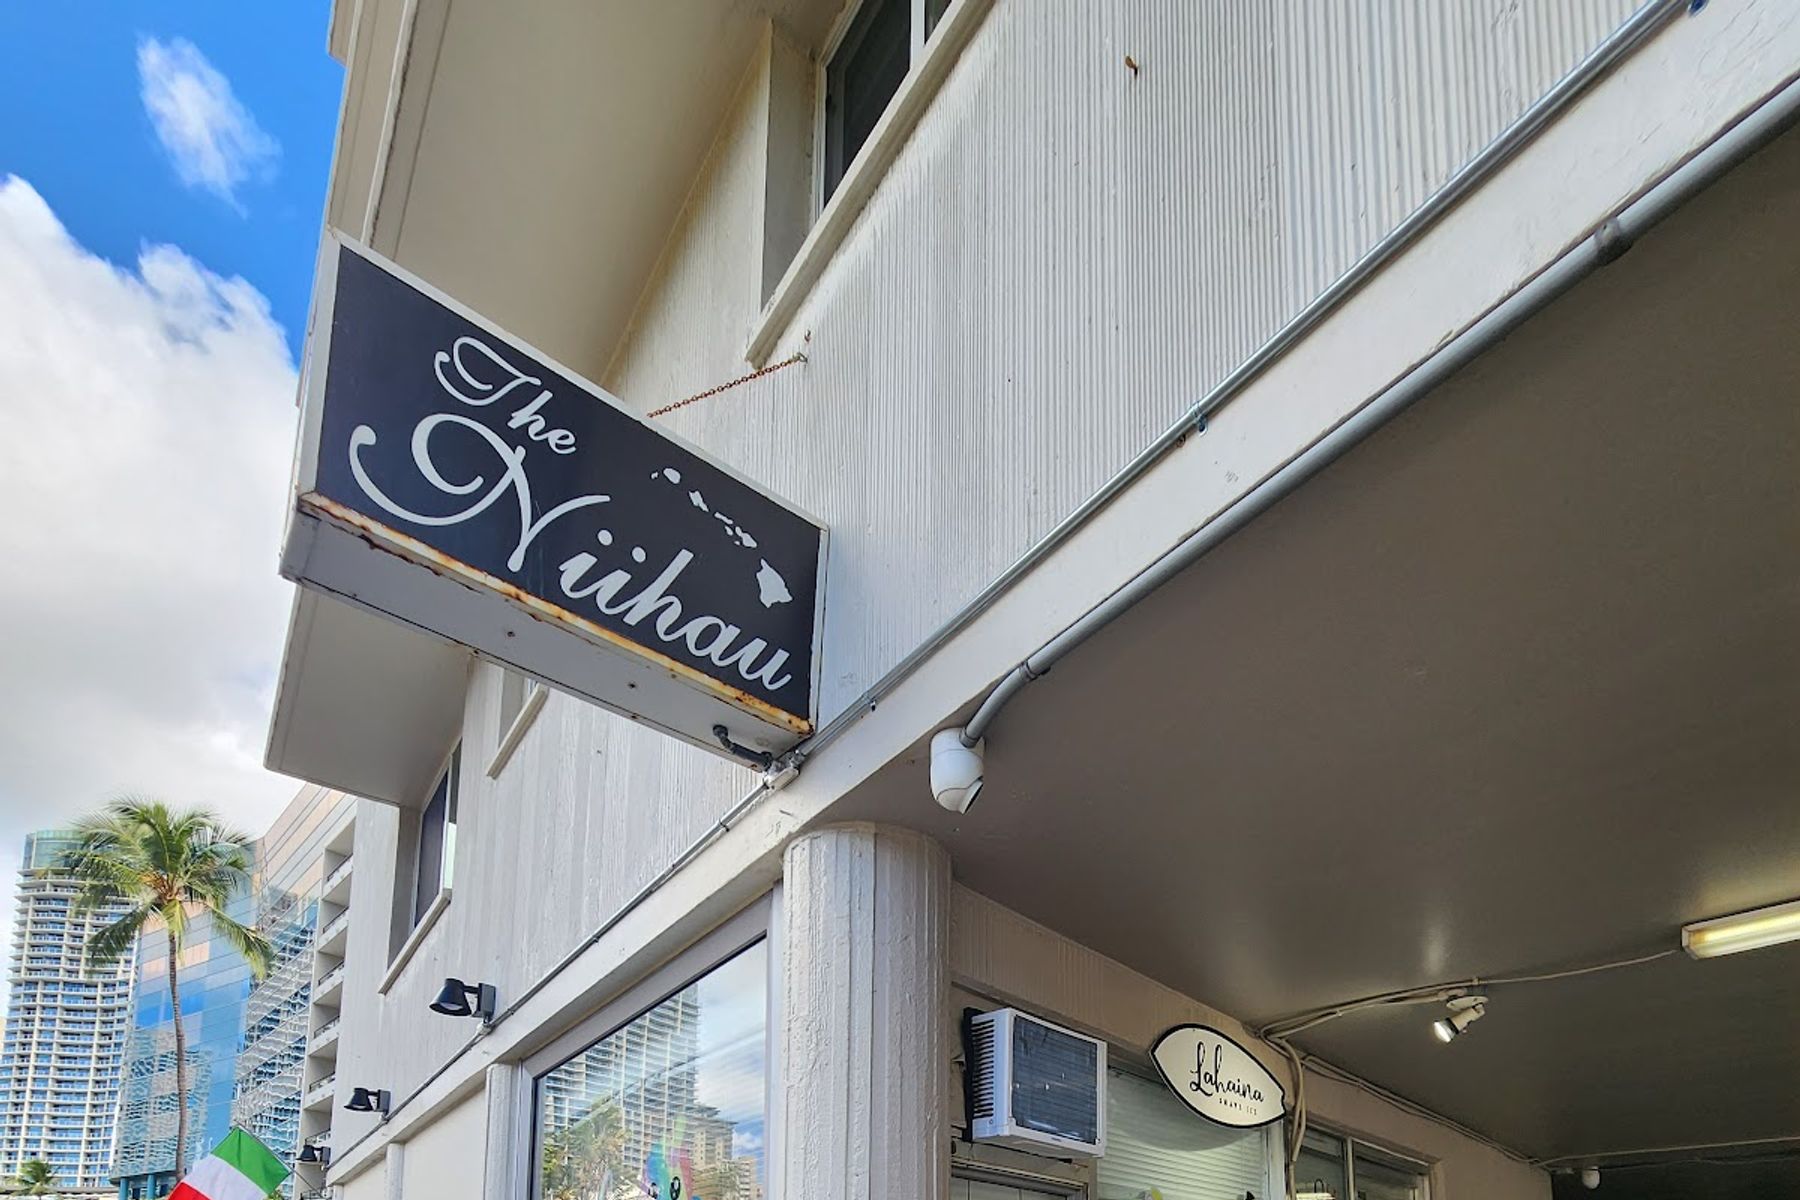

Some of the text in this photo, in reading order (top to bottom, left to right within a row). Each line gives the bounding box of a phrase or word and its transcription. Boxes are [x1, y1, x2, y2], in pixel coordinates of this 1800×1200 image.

[434, 335, 577, 455] The
[348, 413, 792, 691] Niihau
[1190, 1041, 1264, 1103] Lahaina
